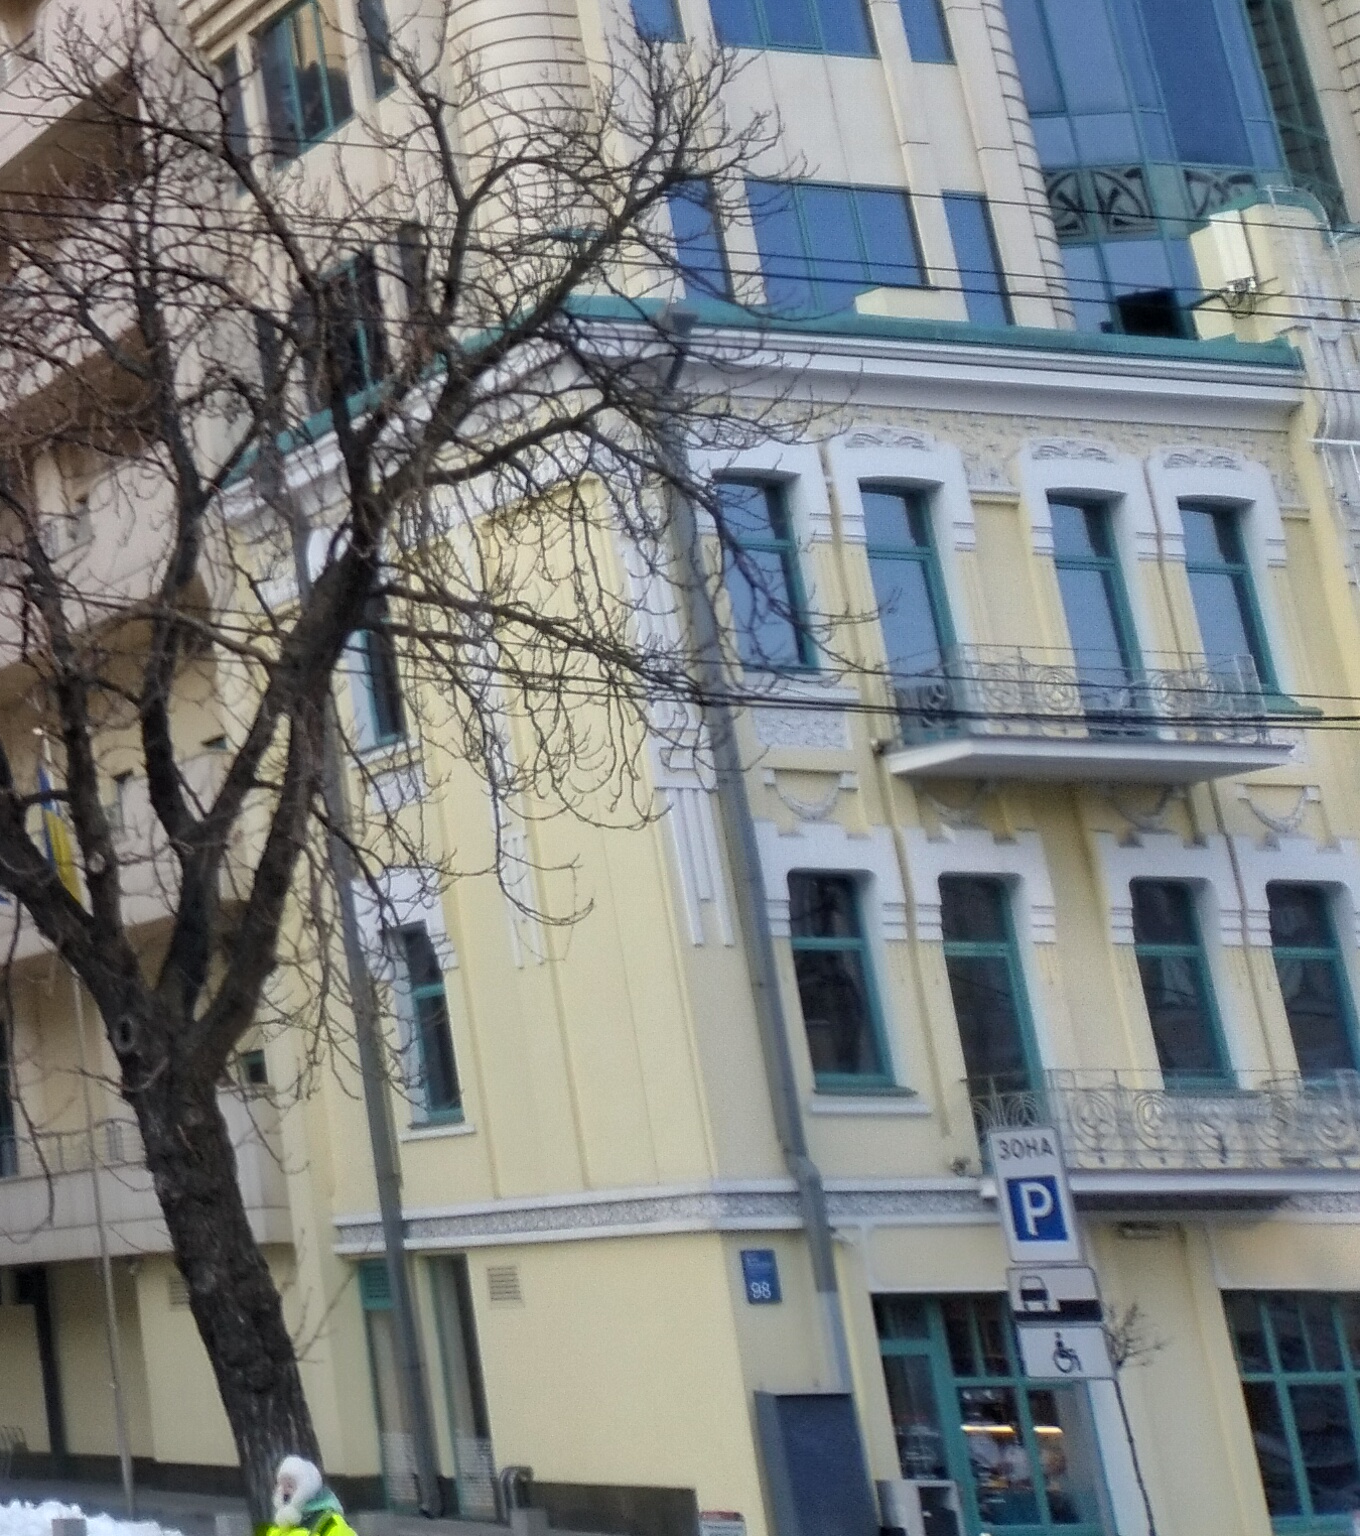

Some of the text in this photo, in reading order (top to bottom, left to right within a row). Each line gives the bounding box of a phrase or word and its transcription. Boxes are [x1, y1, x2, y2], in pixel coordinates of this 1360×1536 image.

[998, 1137, 1055, 1160] ЗОНА
[1019, 1182, 1053, 1236] P
[751, 1281, 772, 1299] 98
